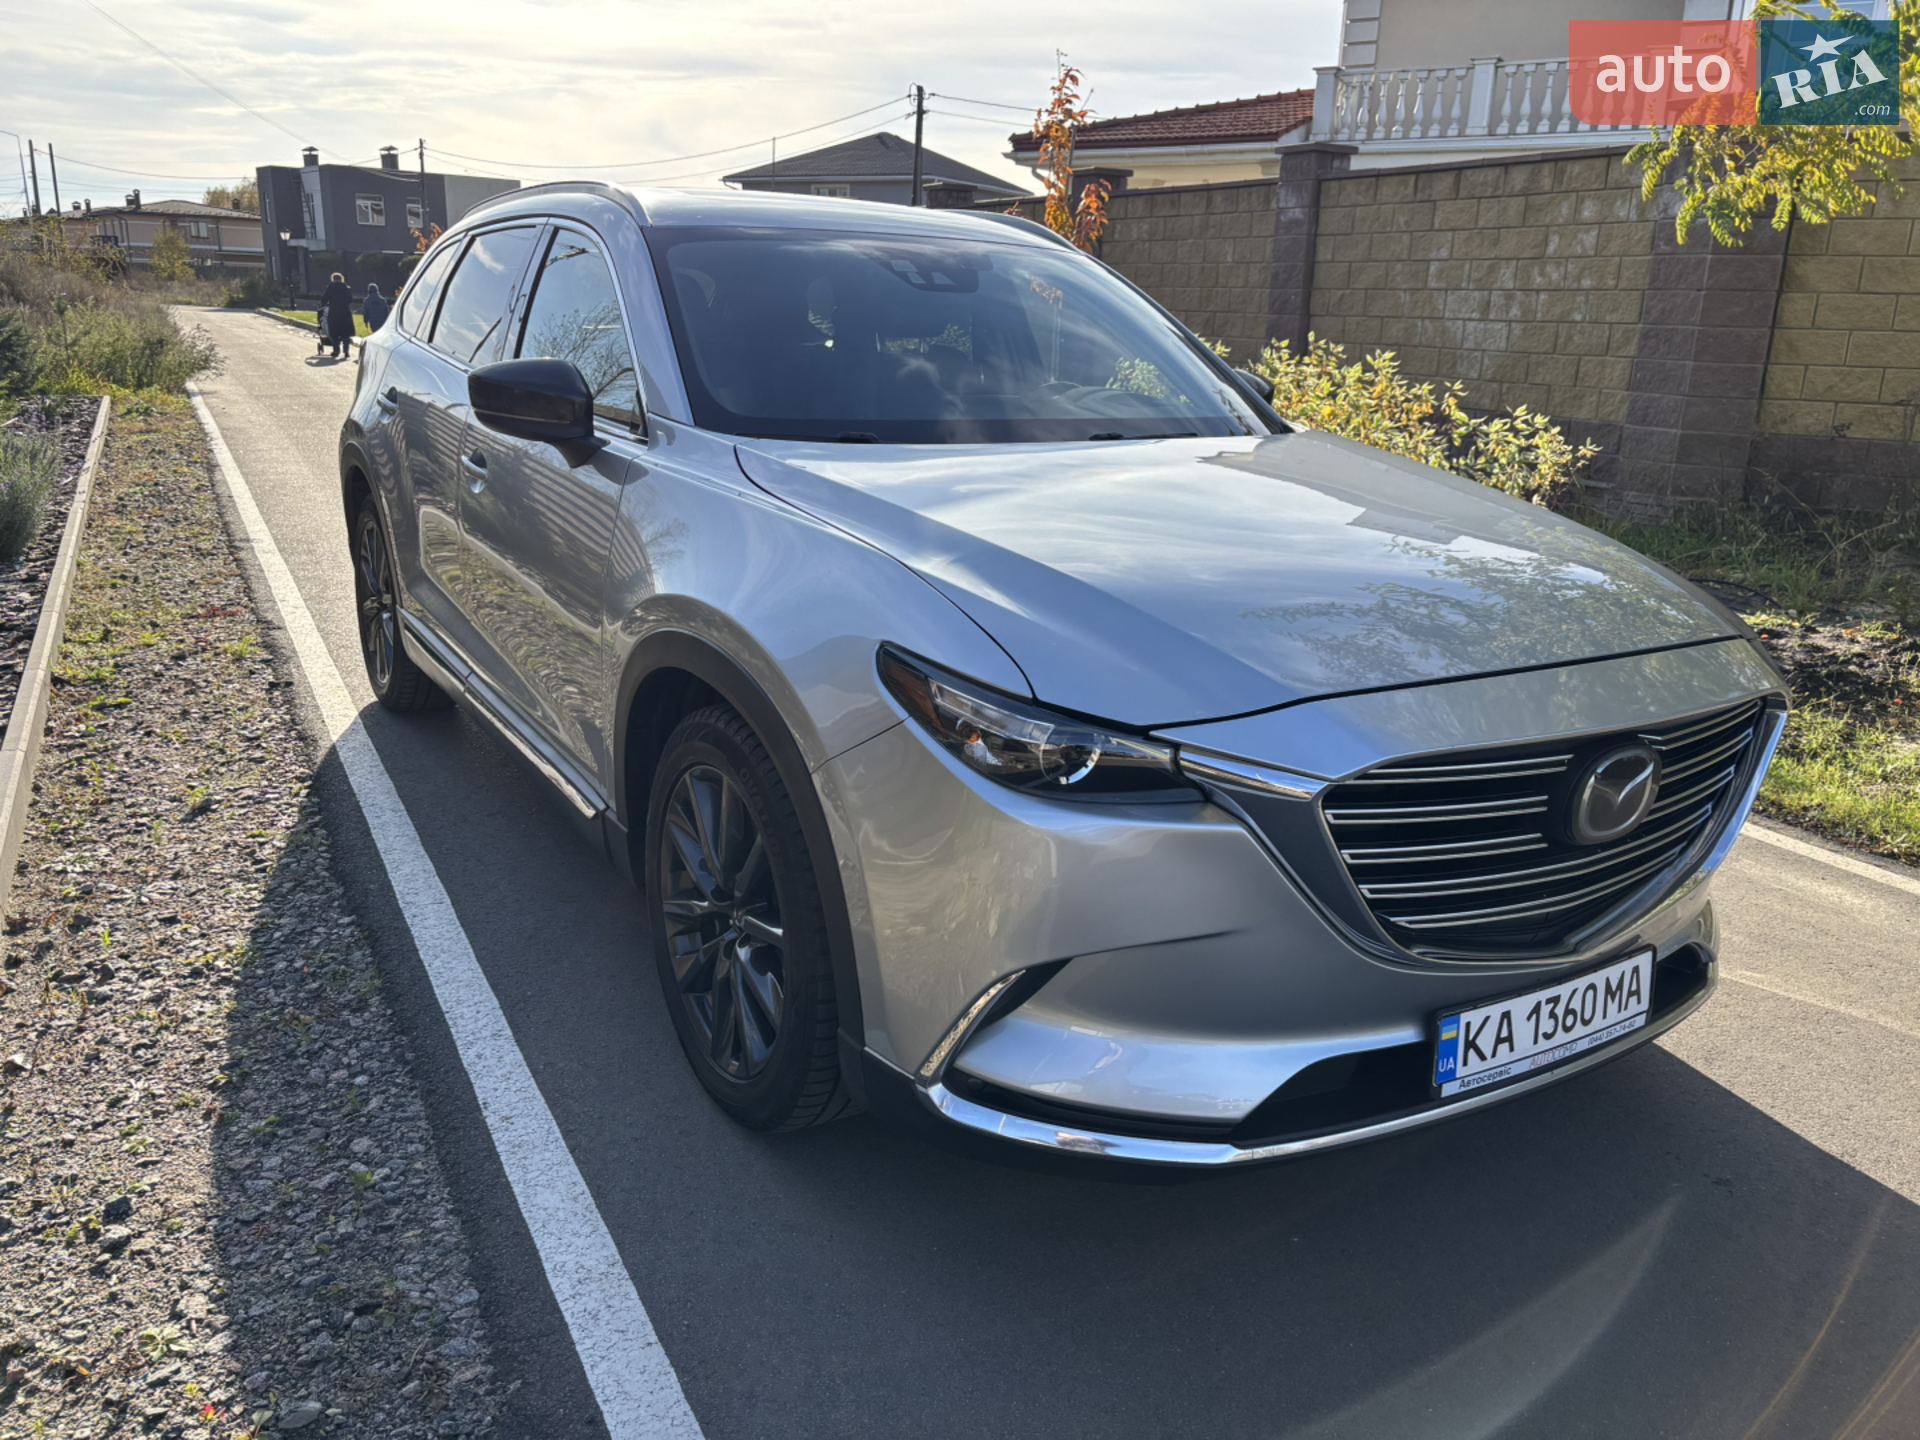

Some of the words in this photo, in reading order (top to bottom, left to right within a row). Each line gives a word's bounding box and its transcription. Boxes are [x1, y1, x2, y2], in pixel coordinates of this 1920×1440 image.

[1462, 1010, 1514, 1067] KA
[1527, 983, 1598, 1045] 1360
[1602, 965, 1642, 1020] MA
[1439, 1056, 1455, 1072] UA
[1458, 1067, 1512, 1090] Автосервіс
